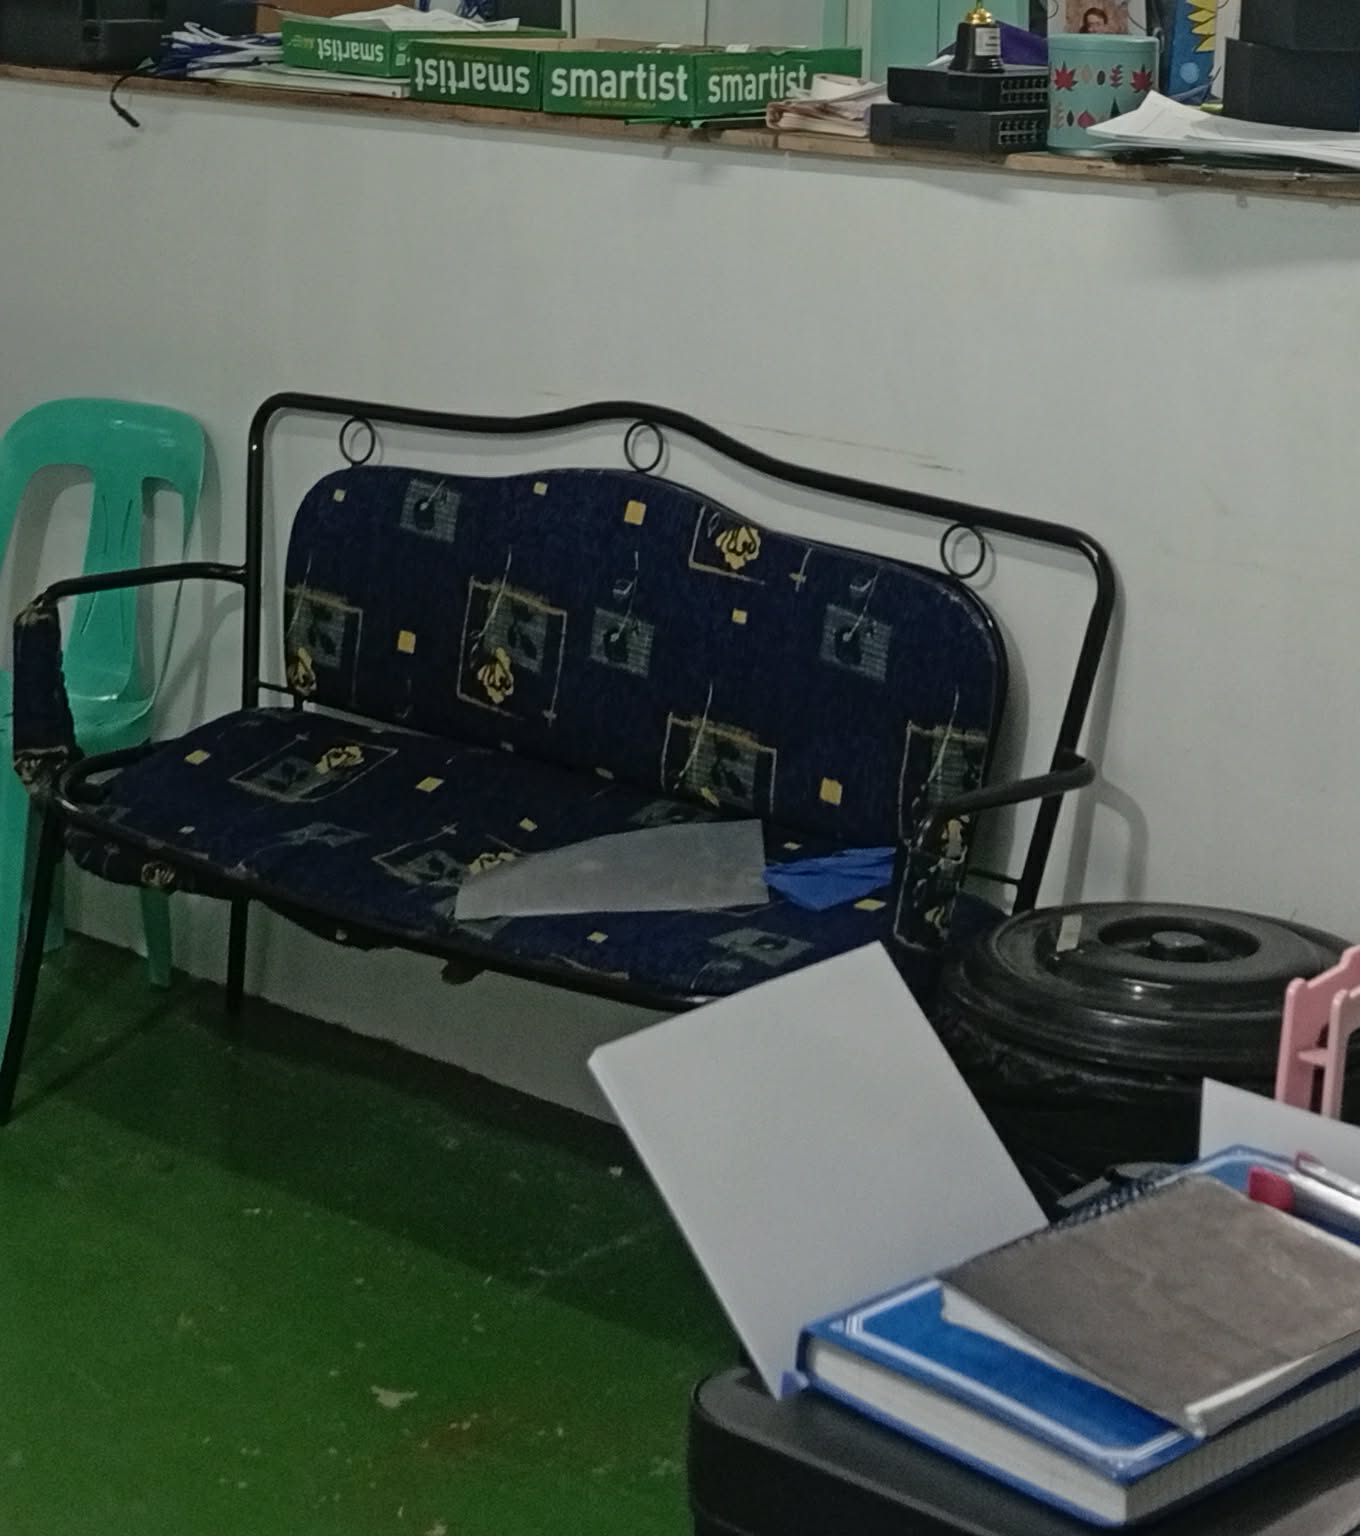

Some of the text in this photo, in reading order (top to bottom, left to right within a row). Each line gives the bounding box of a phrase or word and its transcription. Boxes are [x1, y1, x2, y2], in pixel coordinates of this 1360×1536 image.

[317, 37, 384, 63] smartist
[415, 57, 530, 94] smartist
[551, 64, 688, 102] smartist
[708, 64, 807, 103] smartist
